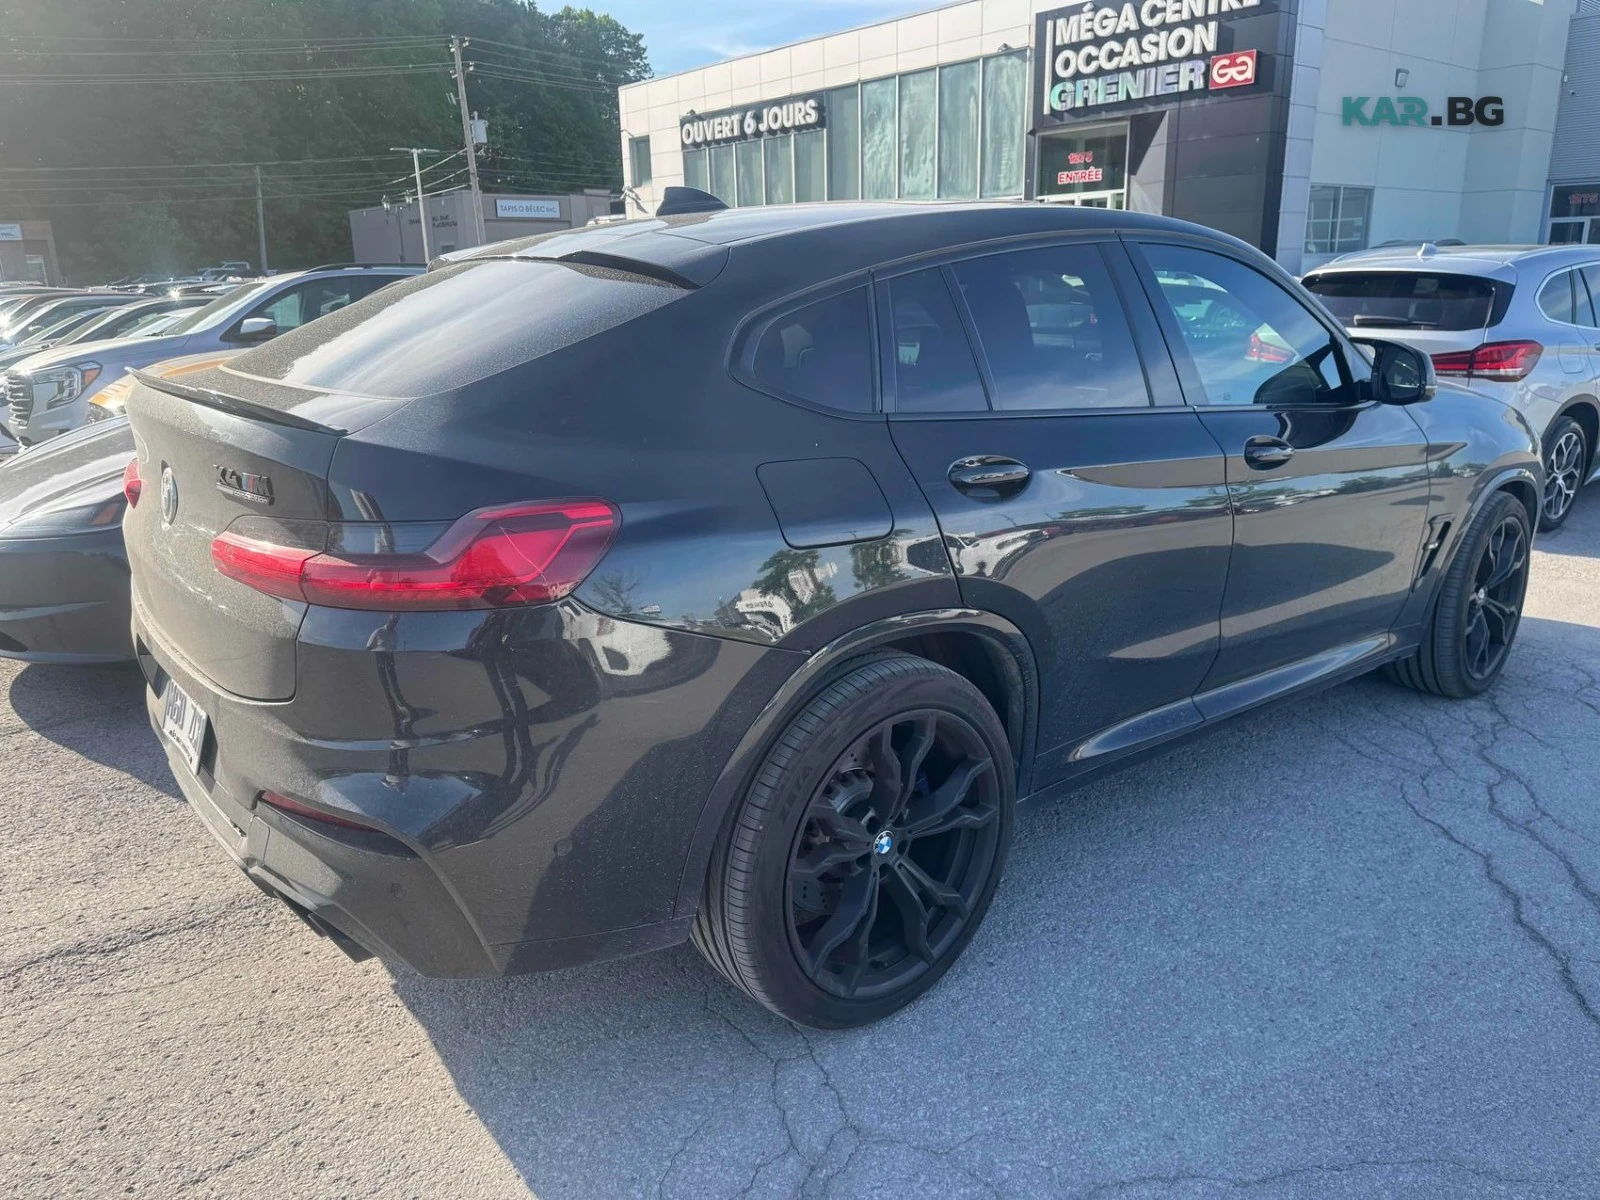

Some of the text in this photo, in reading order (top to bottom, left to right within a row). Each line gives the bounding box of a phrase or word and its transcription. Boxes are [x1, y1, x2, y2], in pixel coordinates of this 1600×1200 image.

[1055, 0, 1262, 46] MÉGA CENT
[1055, 20, 1218, 78] OCCASION
[1050, 59, 1206, 112] GRENIER
[682, 99, 818, 145] OUVERT 6 JOURS
[1058, 166, 1102, 184] ENTRÉE
[500, 204, 518, 213] TAPIS
